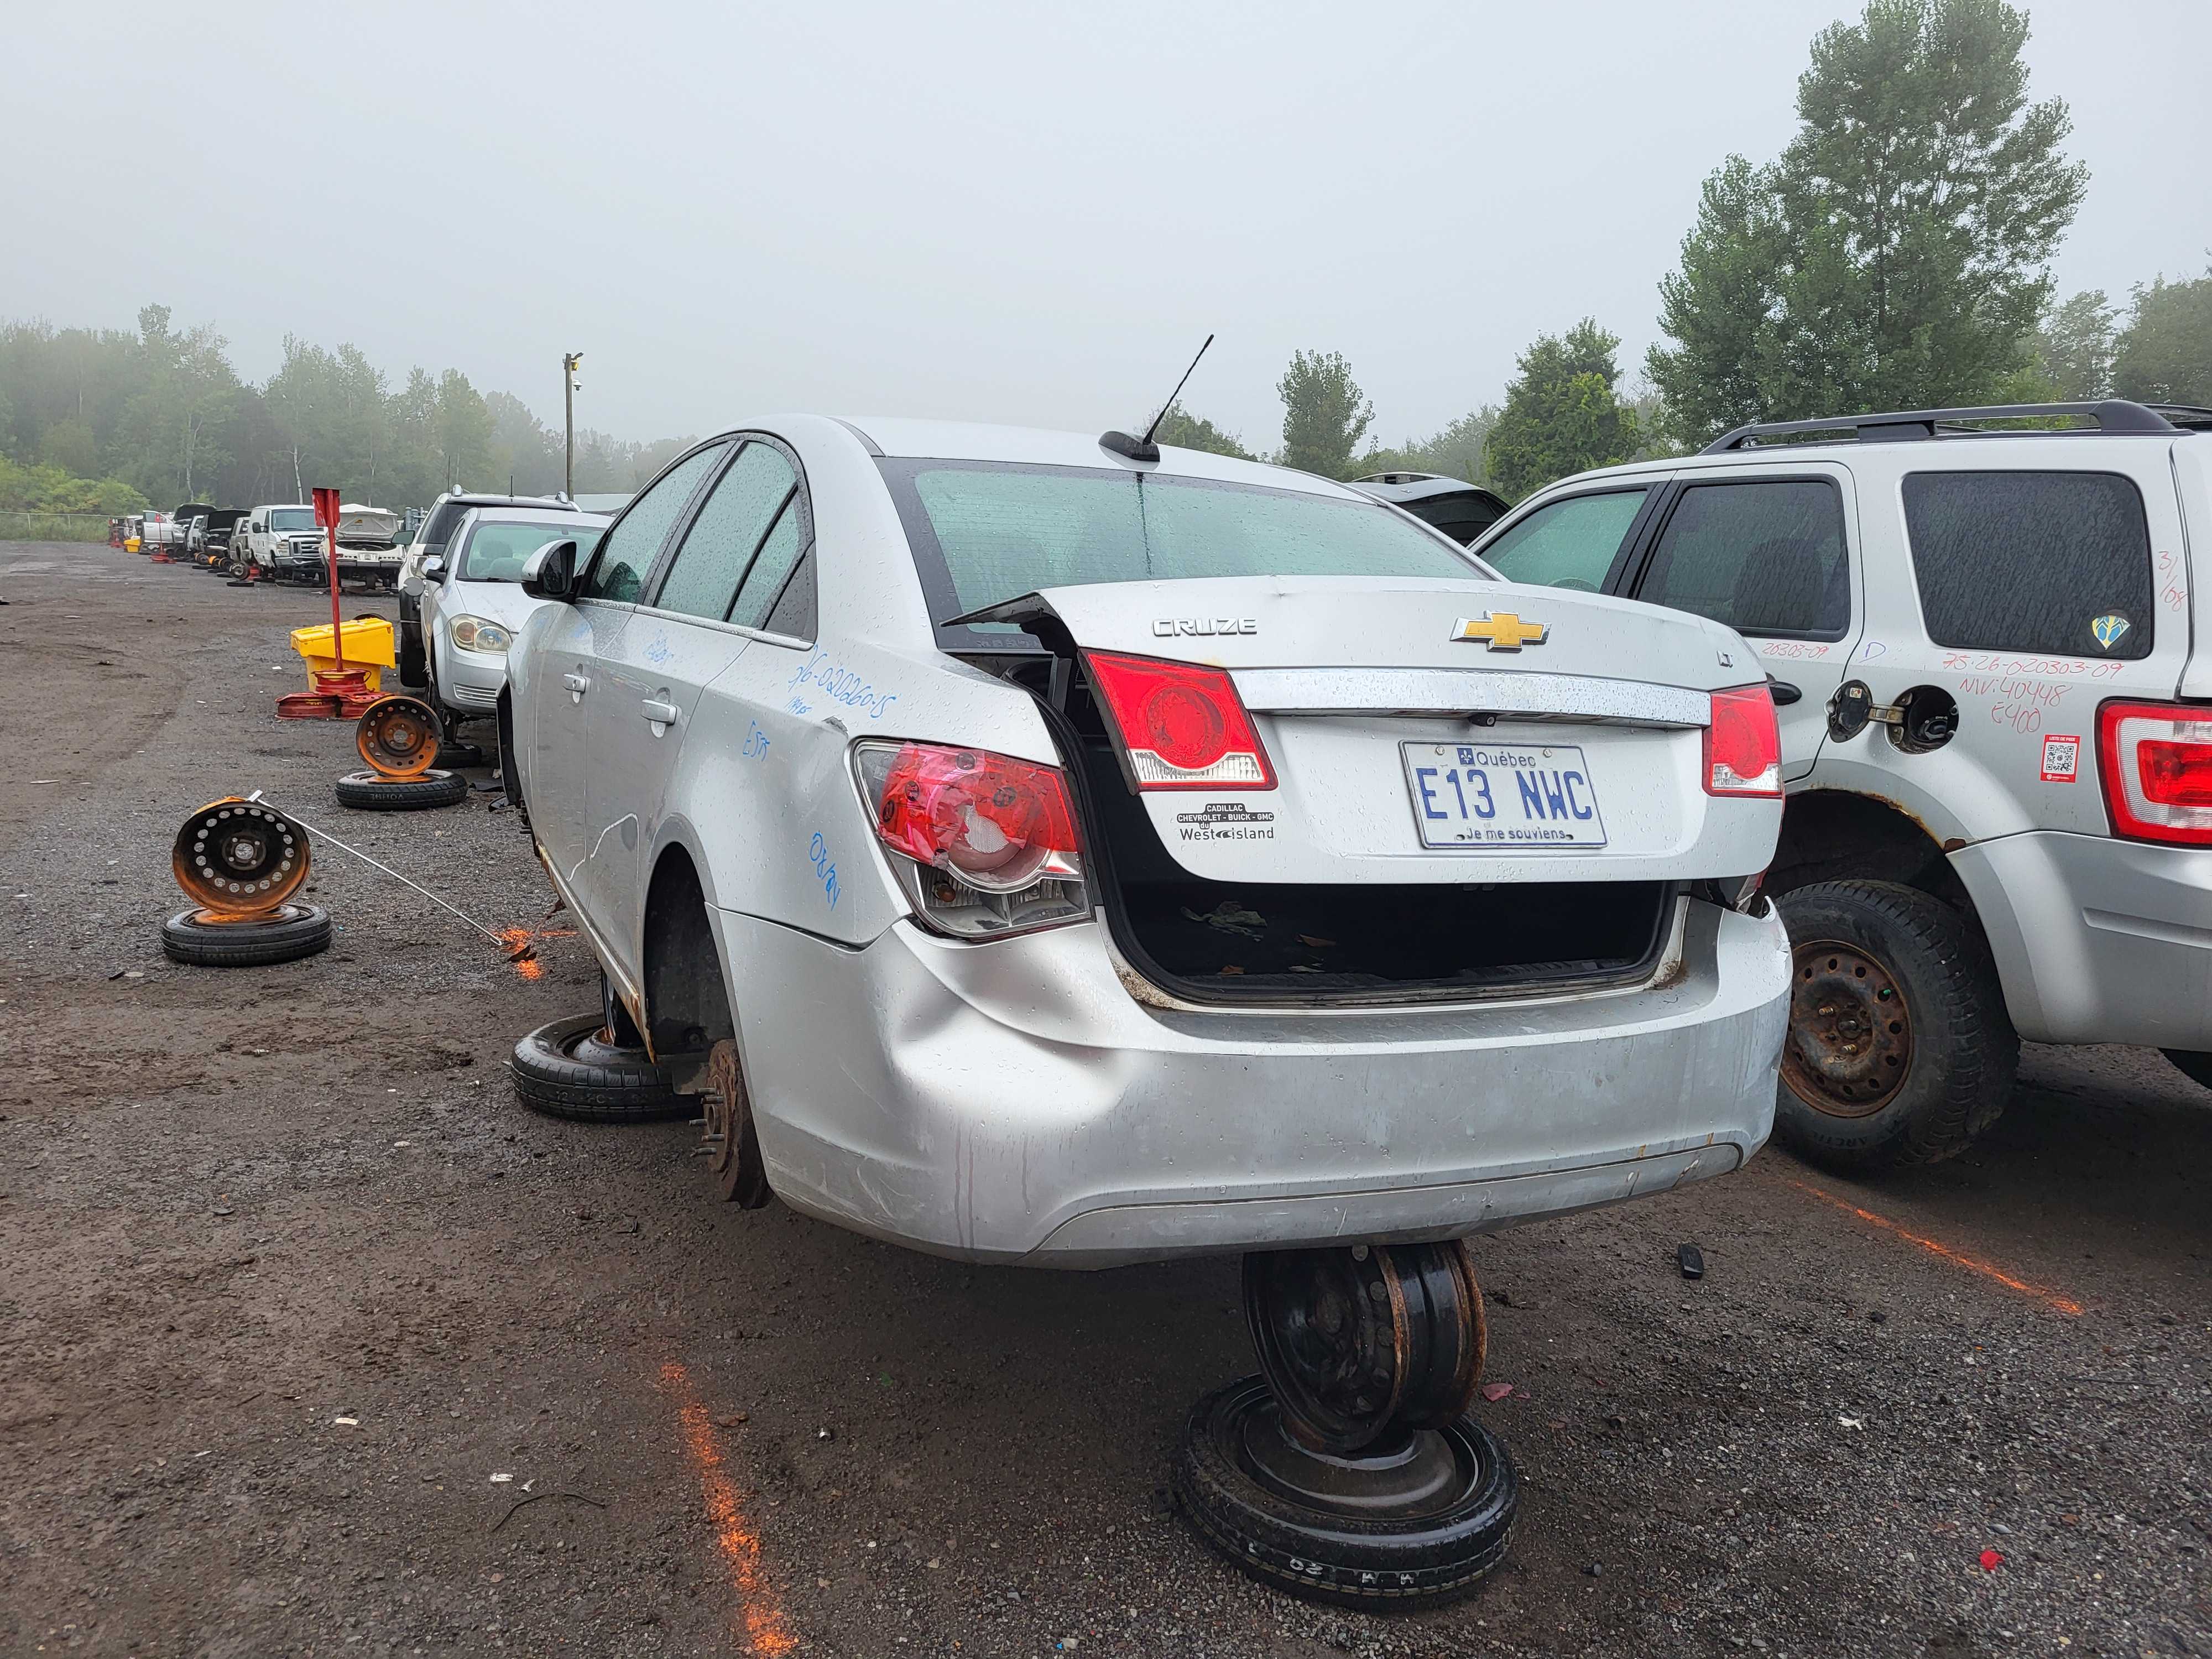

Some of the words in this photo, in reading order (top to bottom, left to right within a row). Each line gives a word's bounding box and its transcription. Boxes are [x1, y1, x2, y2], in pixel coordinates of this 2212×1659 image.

[1153, 618, 1258, 637] CRUZE
[1477, 751, 1536, 766] Québec
[1416, 768, 1496, 819] E13
[1515, 770, 1593, 820] NWC
[1180, 828, 1215, 840] West
[1232, 827, 1274, 839] island
[1467, 828, 1481, 839] Je
[1486, 830, 1505, 839] me
[1508, 827, 1566, 839] souviens
